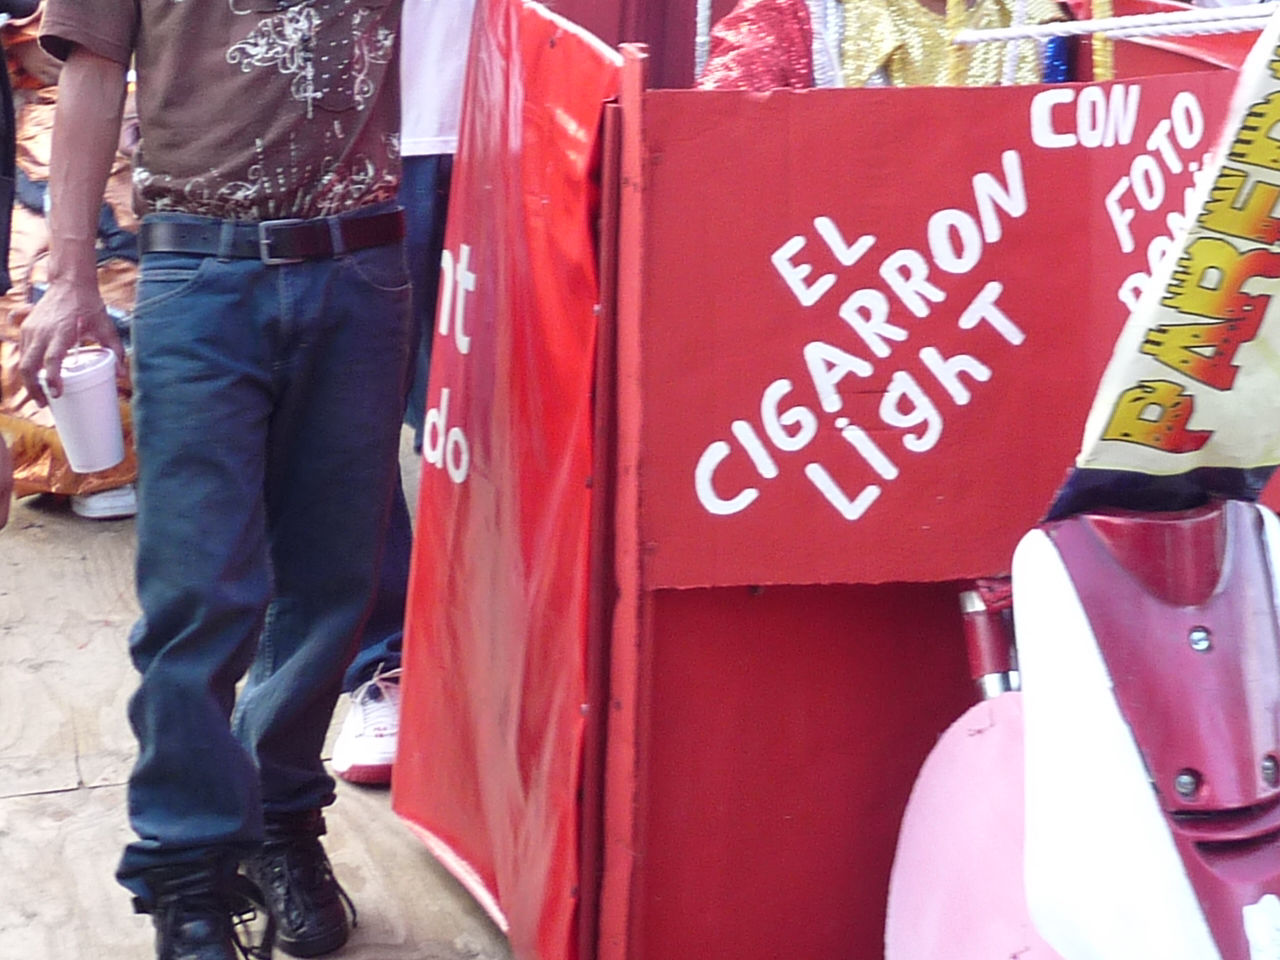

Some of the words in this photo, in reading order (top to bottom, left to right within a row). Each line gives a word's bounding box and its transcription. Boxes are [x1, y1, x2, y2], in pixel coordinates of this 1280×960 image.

[1030, 84, 1141, 148] CON
[1104, 91, 1205, 254] FOTO
[771, 215, 877, 307] EL
[695, 149, 1028, 516] CIGARRON
